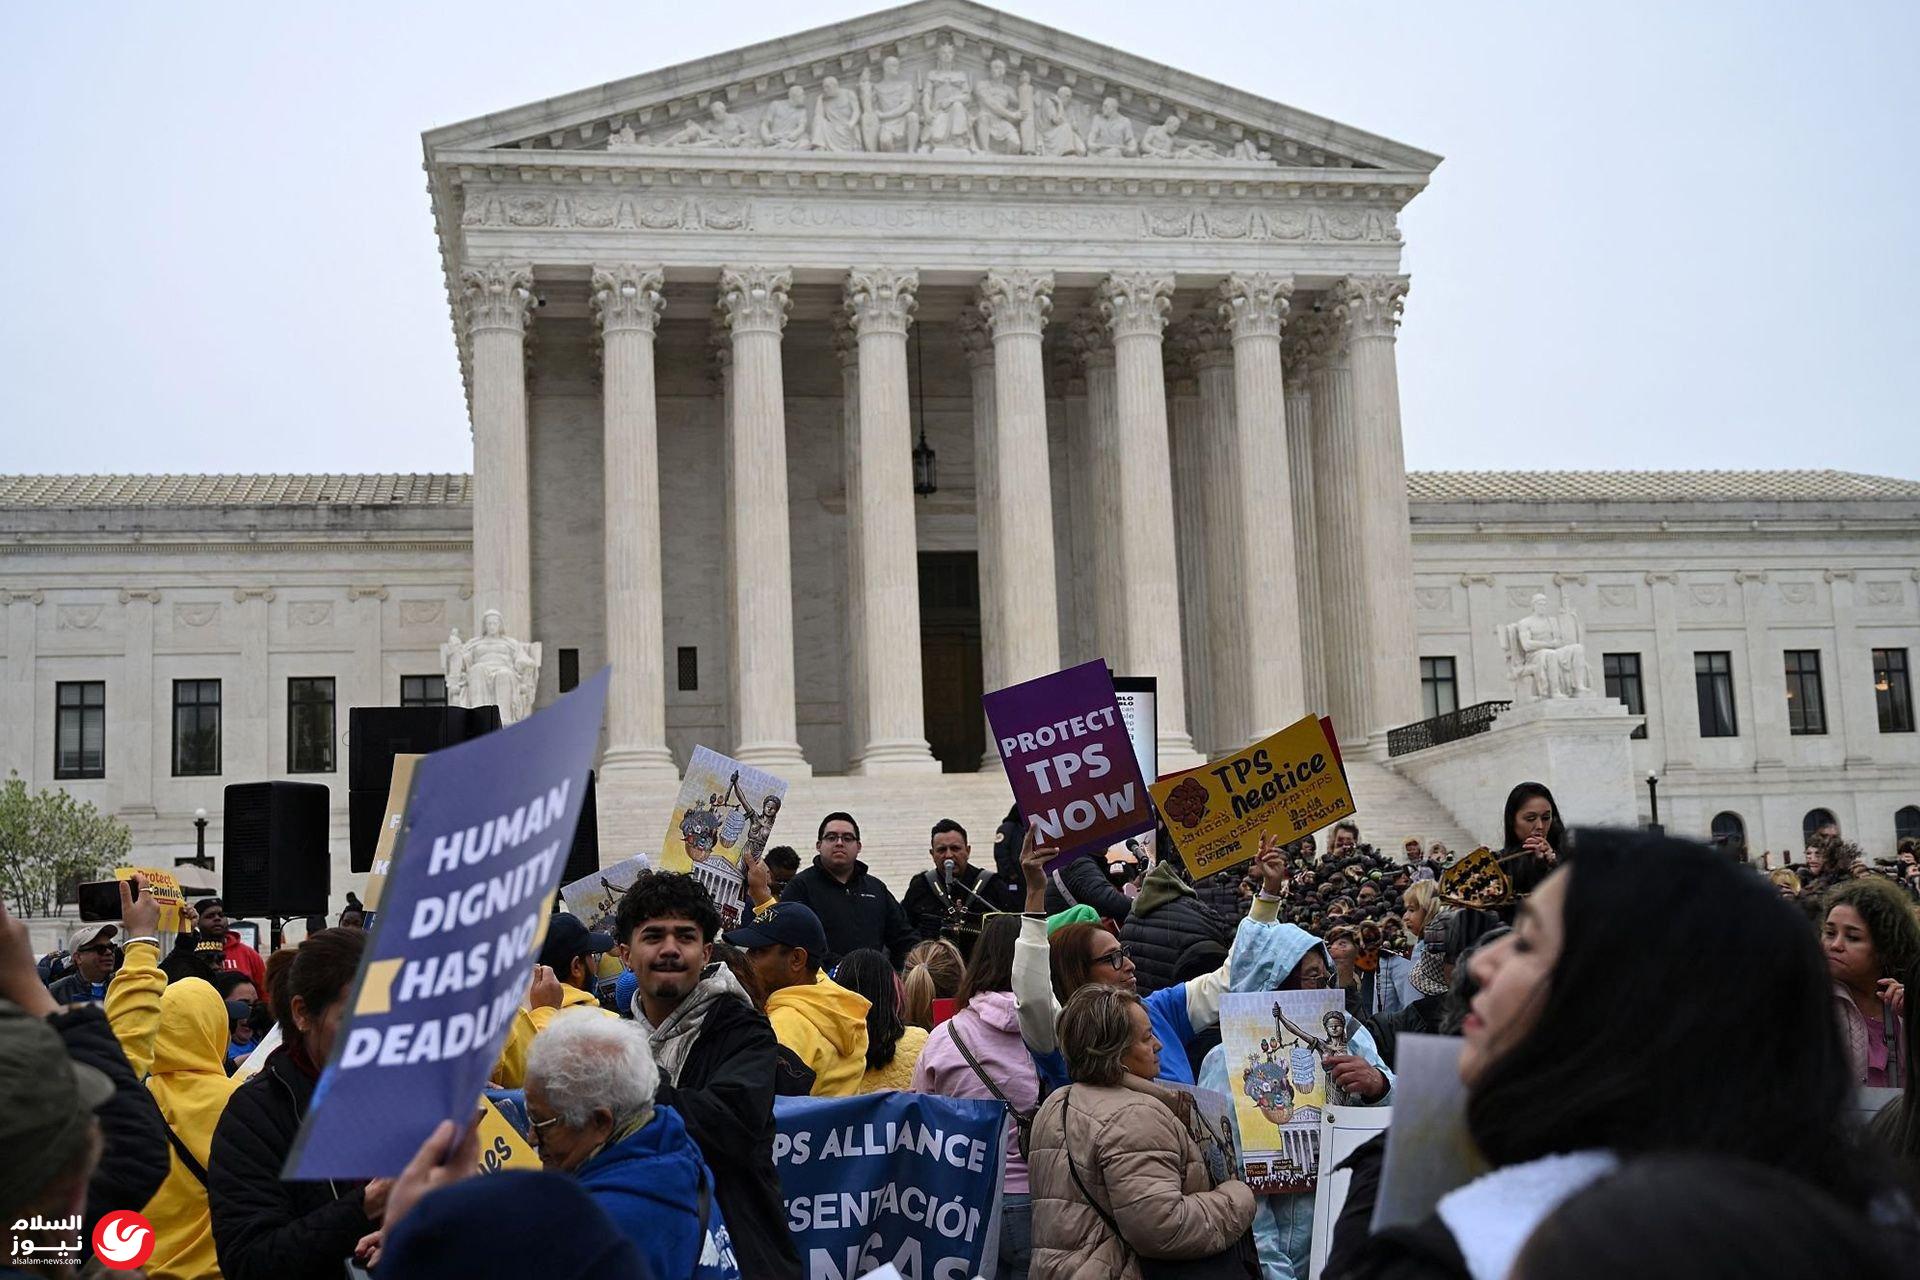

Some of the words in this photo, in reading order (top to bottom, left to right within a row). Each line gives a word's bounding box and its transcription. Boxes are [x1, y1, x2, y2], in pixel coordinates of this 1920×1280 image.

[772, 205, 862, 227] EQUAL
[867, 208, 968, 229] JUSTICE
[980, 209, 1066, 230] UNDER
[1075, 210, 1124, 231] LAW
[1001, 706, 1115, 758] PROTECT
[1025, 743, 1111, 794] TPS
[1211, 750, 1273, 793] TPS
[427, 778, 571, 876] HUMAN
[1028, 782, 1135, 846] NOW
[409, 839, 561, 940] DIGNITY
[398, 942, 491, 1002] HAS
[492, 913, 538, 976] NO
[819, 1120, 987, 1173] ALLIANCE
[784, 1182, 981, 1242] SENTACIÓN
